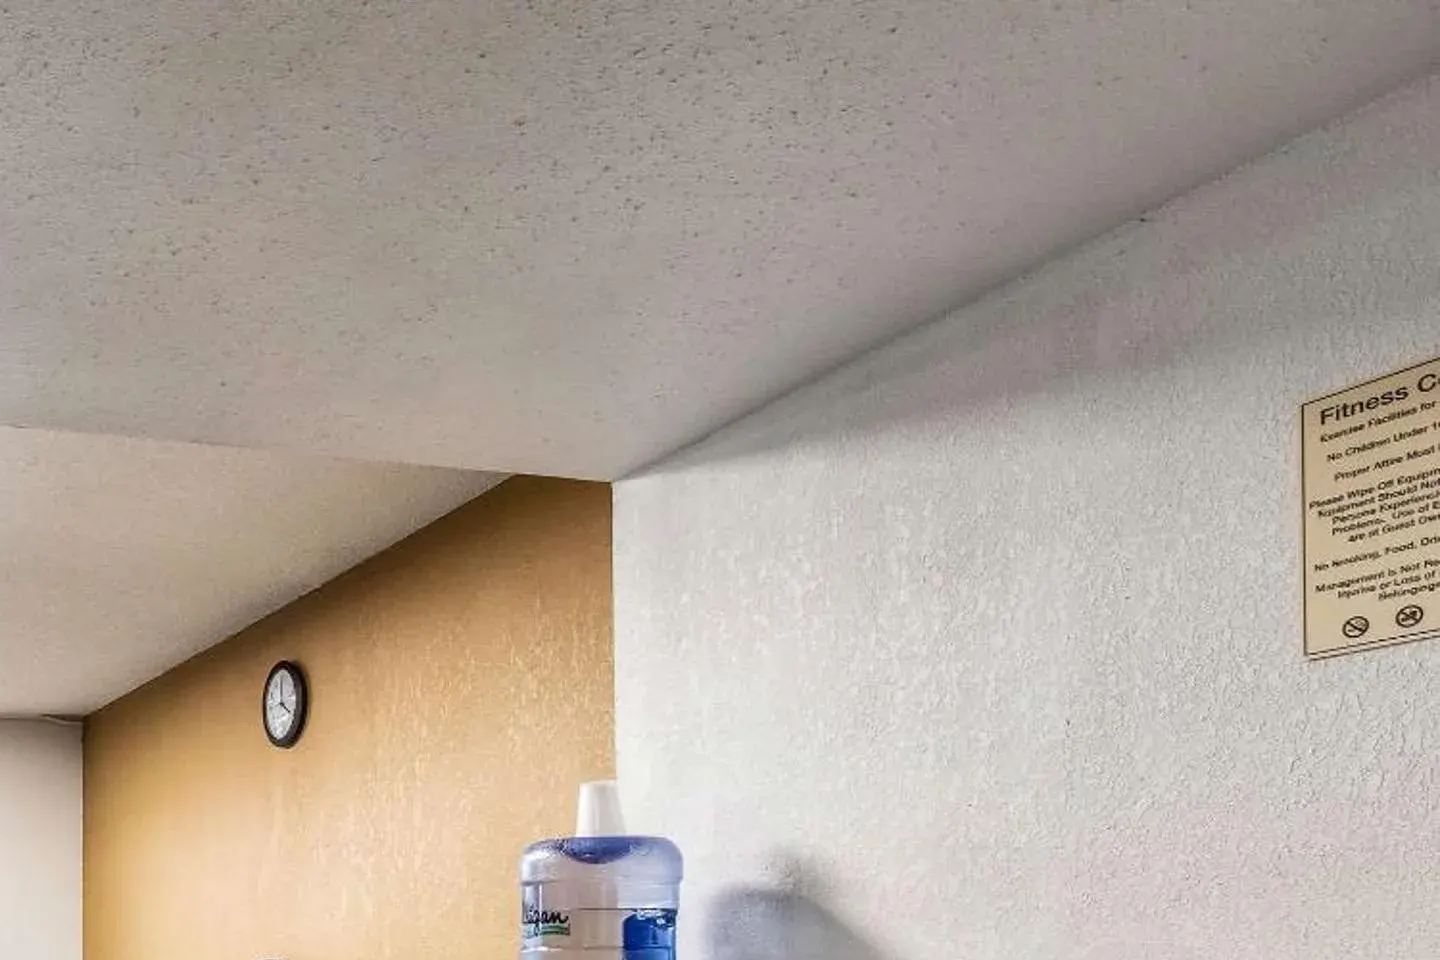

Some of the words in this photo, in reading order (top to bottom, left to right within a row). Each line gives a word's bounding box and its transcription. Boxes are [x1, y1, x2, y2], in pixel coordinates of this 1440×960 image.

[1321, 386, 1409, 426] Fitness
[1417, 373, 1440, 393] C
[1393, 426, 1429, 443] Under
